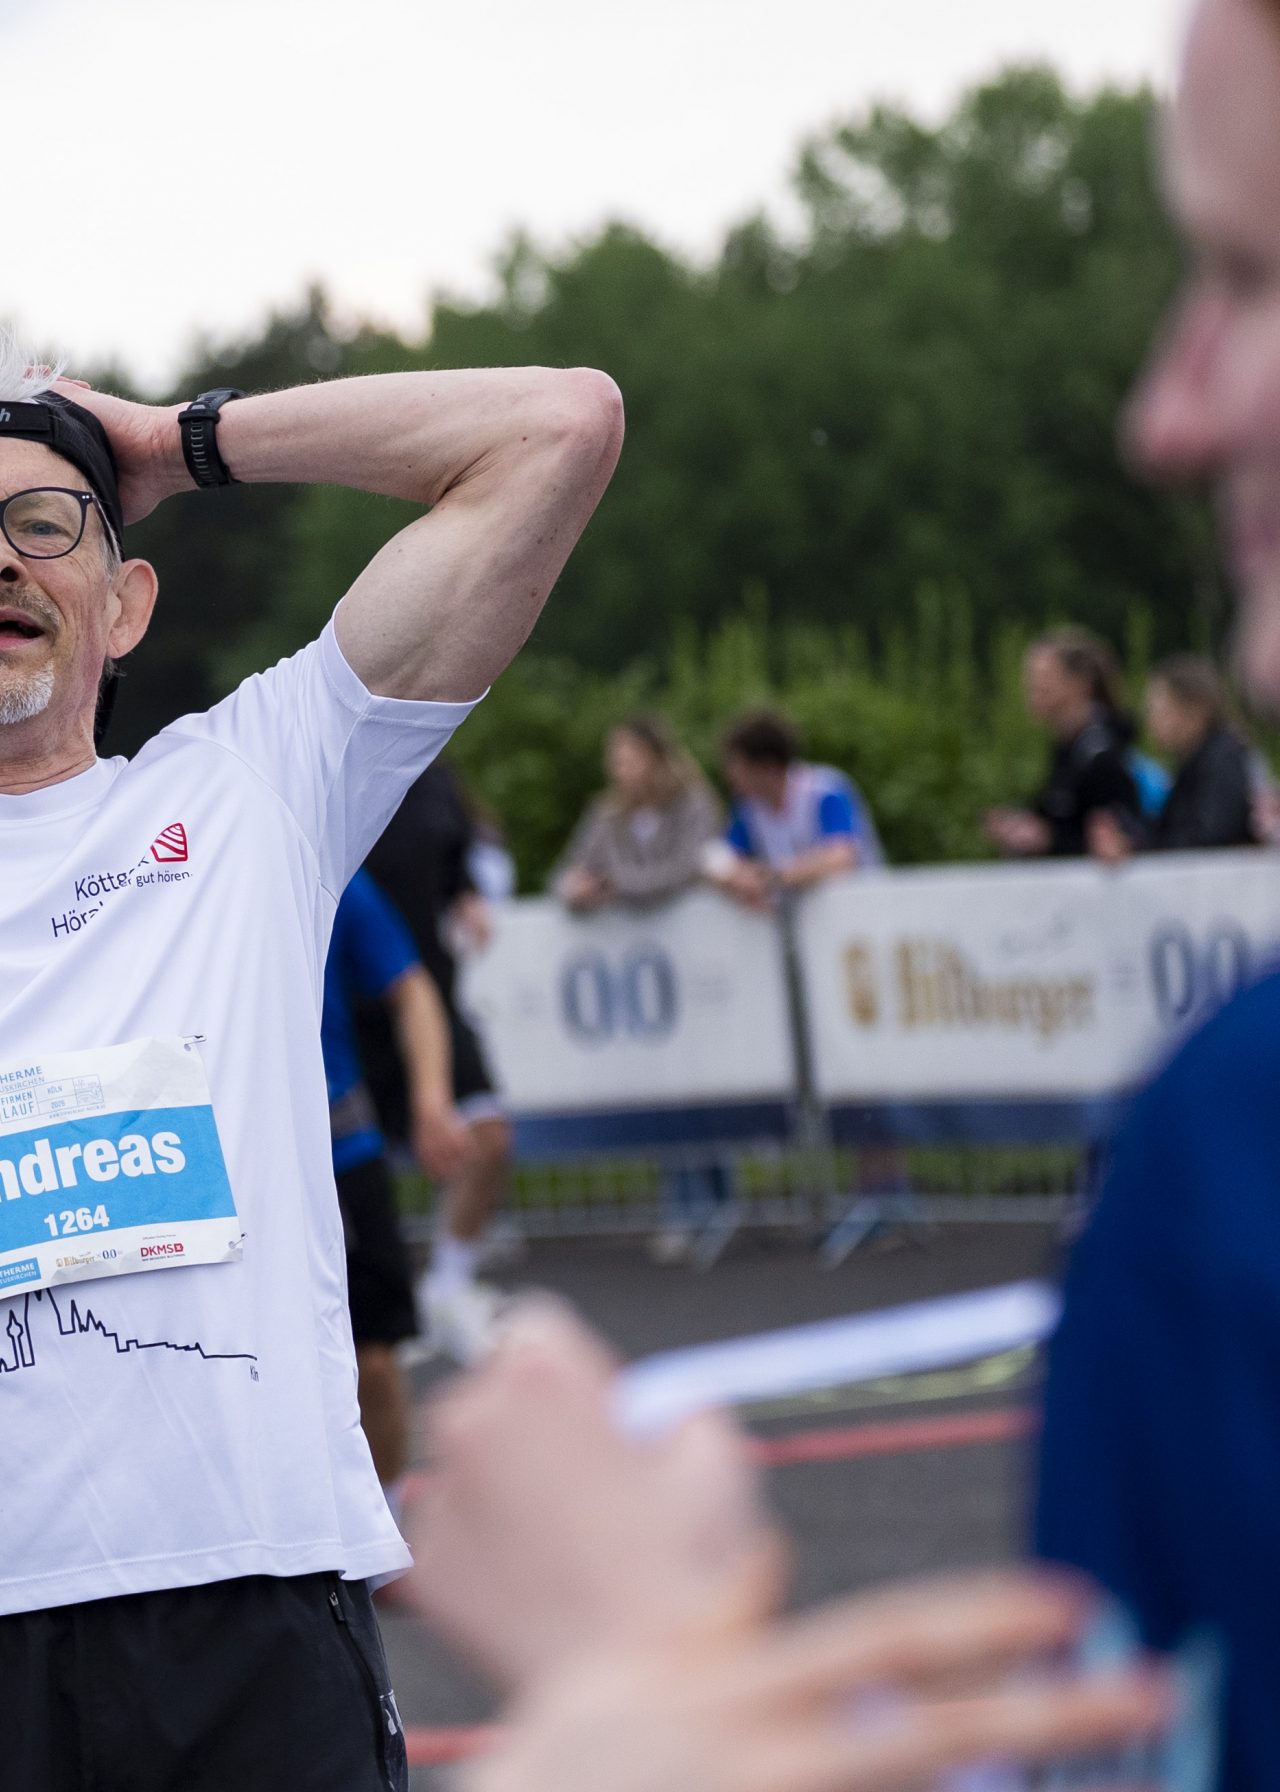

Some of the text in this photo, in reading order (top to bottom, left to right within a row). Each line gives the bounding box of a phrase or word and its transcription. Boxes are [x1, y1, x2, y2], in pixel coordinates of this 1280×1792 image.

[136, 872, 155, 887] gut
[0, 1090, 33, 1106] FIRMEN
[2, 1101, 35, 1119] LAUF
[43, 1204, 110, 1237] 1264
[140, 1243, 174, 1257] DKMS
